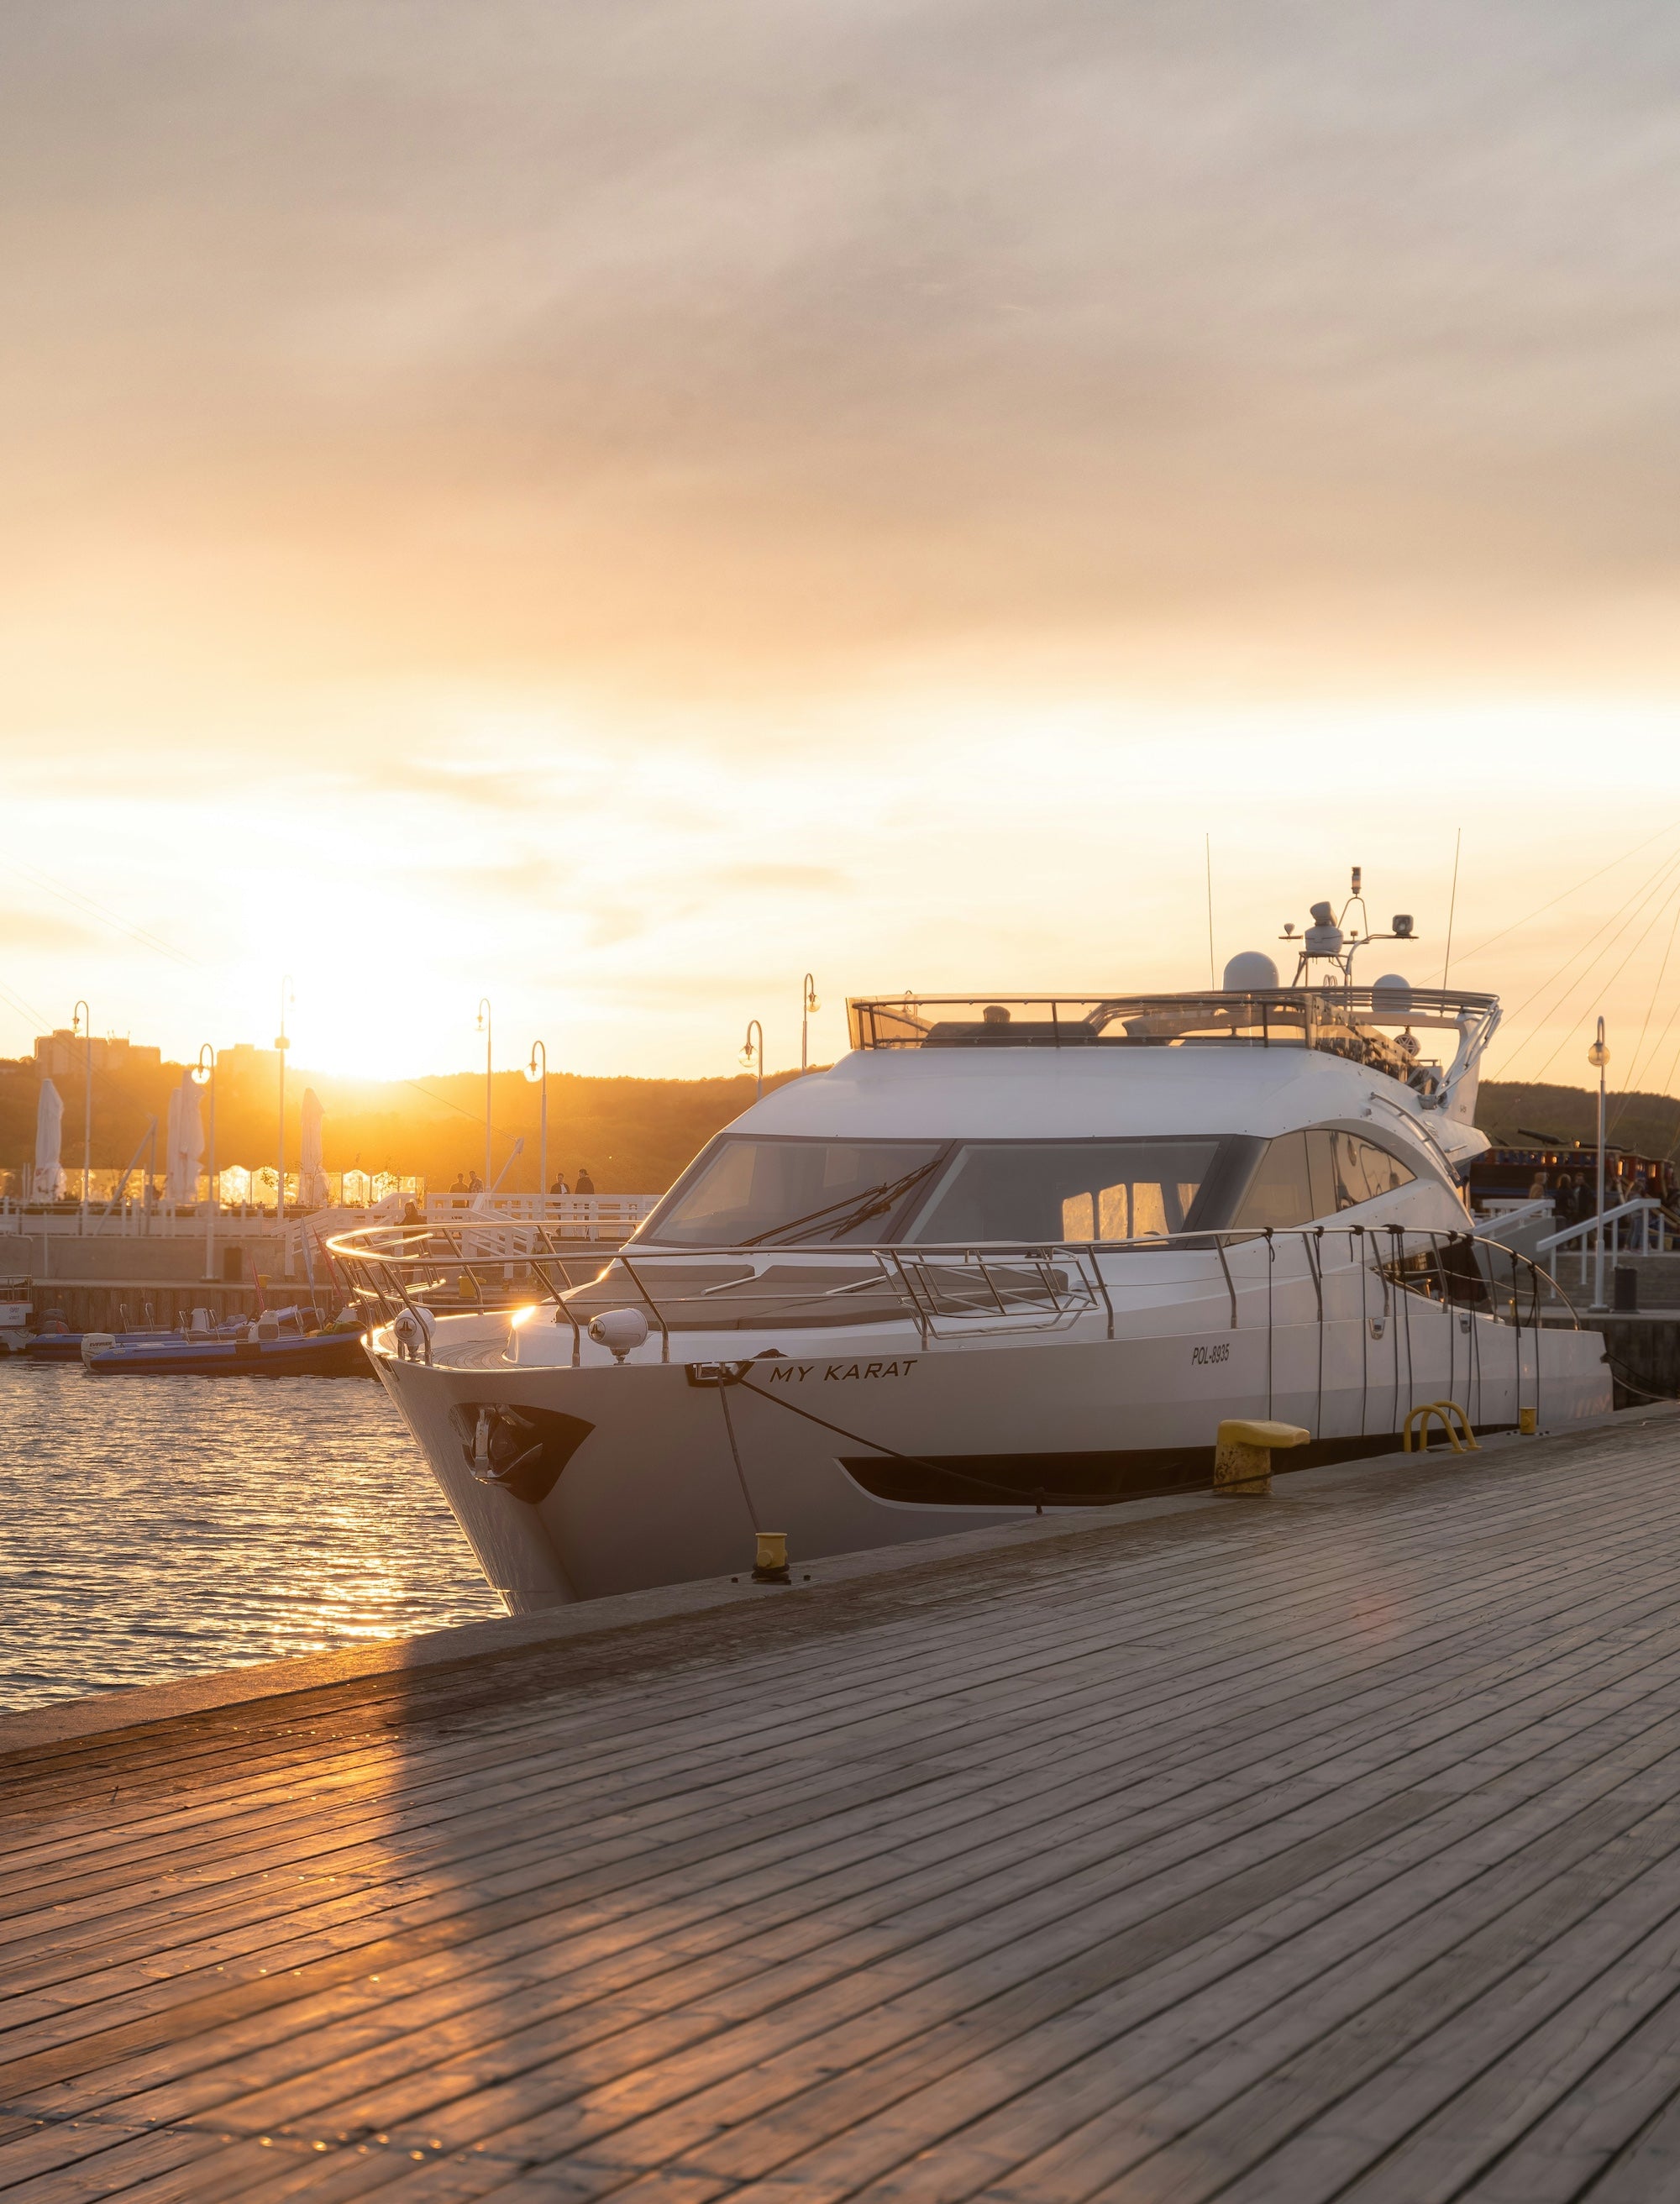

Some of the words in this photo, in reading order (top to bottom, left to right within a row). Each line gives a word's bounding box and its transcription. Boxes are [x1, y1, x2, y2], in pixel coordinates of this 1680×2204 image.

[1191, 1342, 1230, 1365] POL-8935
[769, 1366, 815, 1383] MY
[823, 1360, 918, 1381] KARAT
